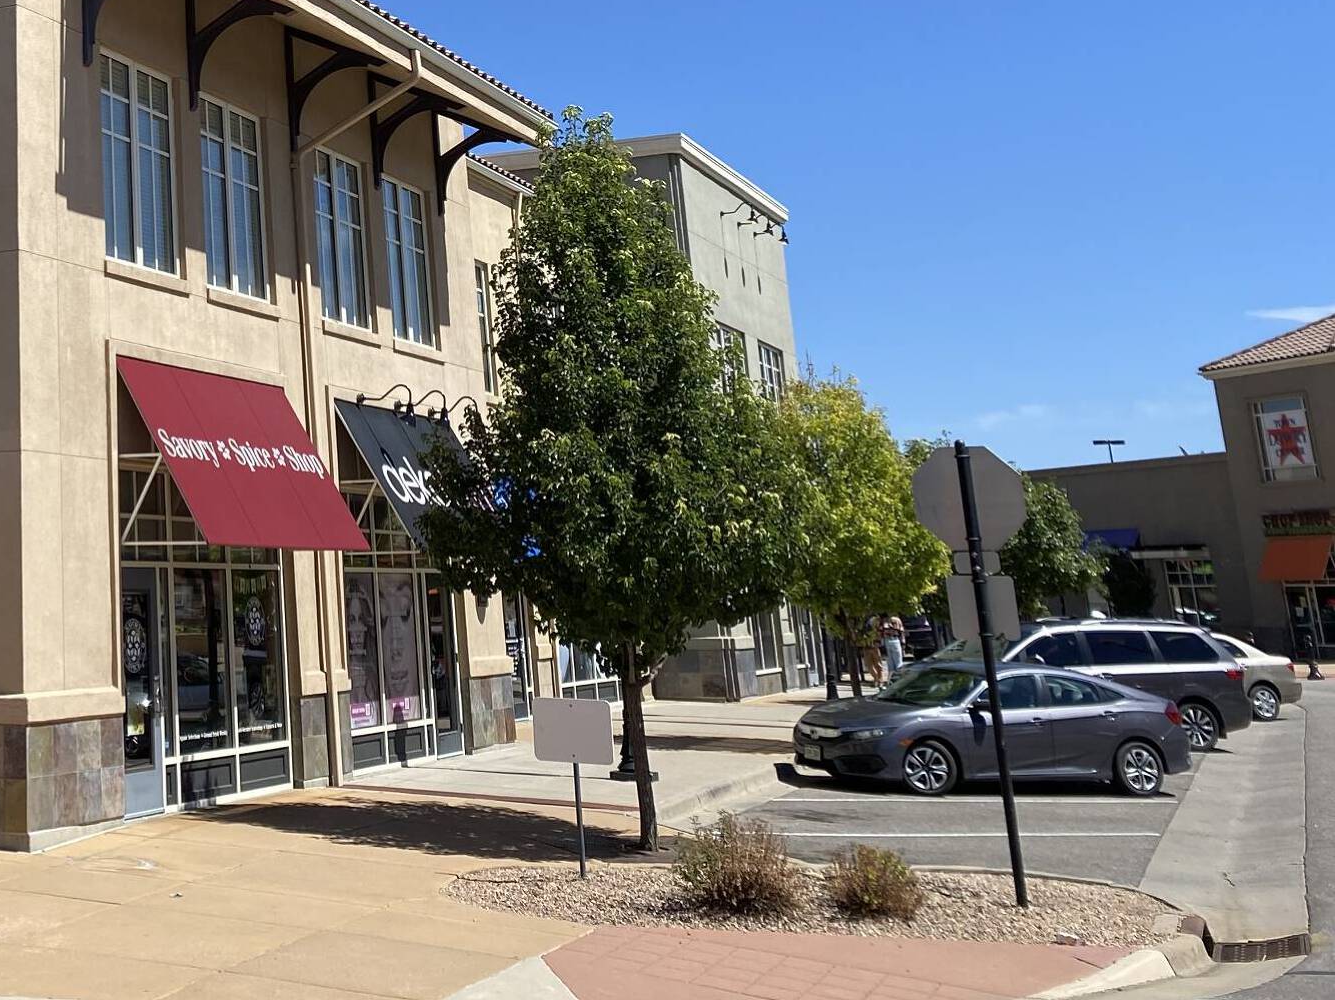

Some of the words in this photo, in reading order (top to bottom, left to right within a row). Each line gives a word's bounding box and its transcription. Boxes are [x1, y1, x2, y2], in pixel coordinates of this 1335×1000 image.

[156, 427, 219, 469] Savory
[227, 438, 272, 474] Spice
[284, 446, 325, 480] Shop
